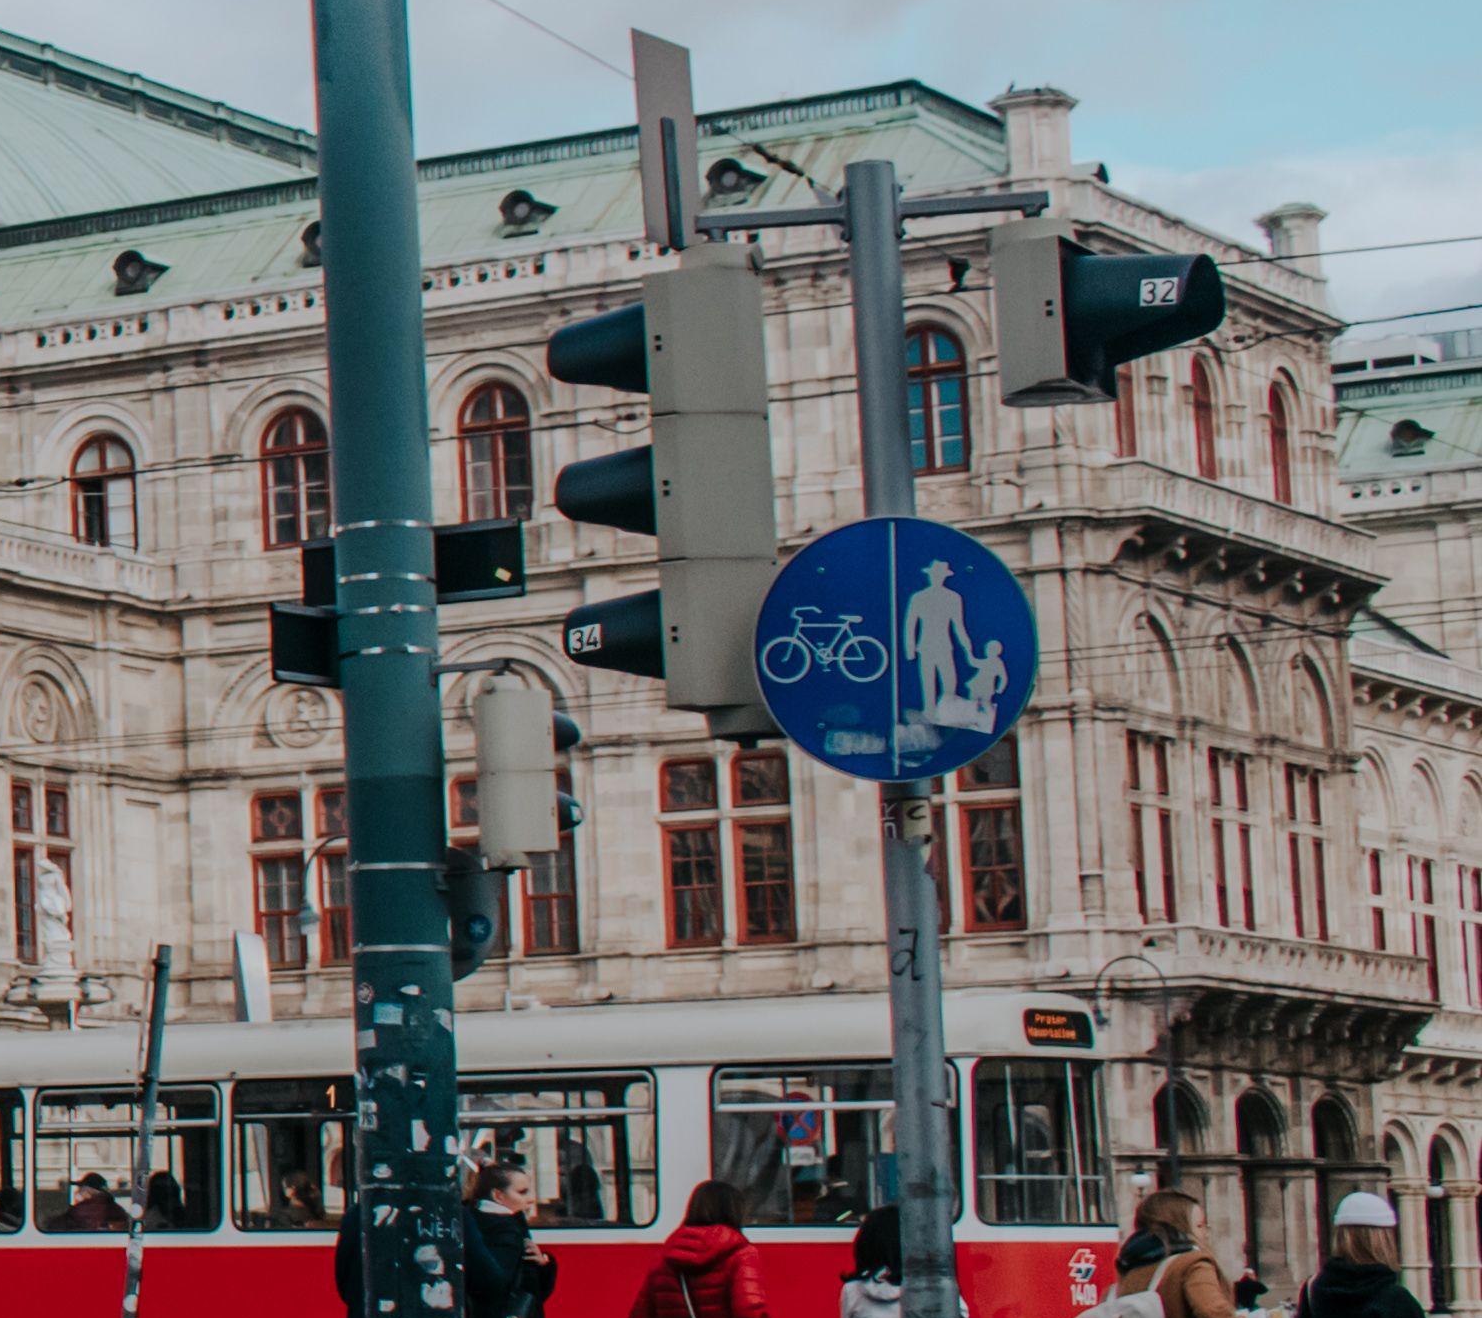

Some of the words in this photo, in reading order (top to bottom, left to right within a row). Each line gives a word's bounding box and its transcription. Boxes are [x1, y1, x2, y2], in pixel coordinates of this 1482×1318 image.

[1142, 280, 1175, 304] 32
[572, 626, 599, 652] 34
[326, 1084, 336, 1109] 1
[1070, 1283, 1097, 1306] 1409
